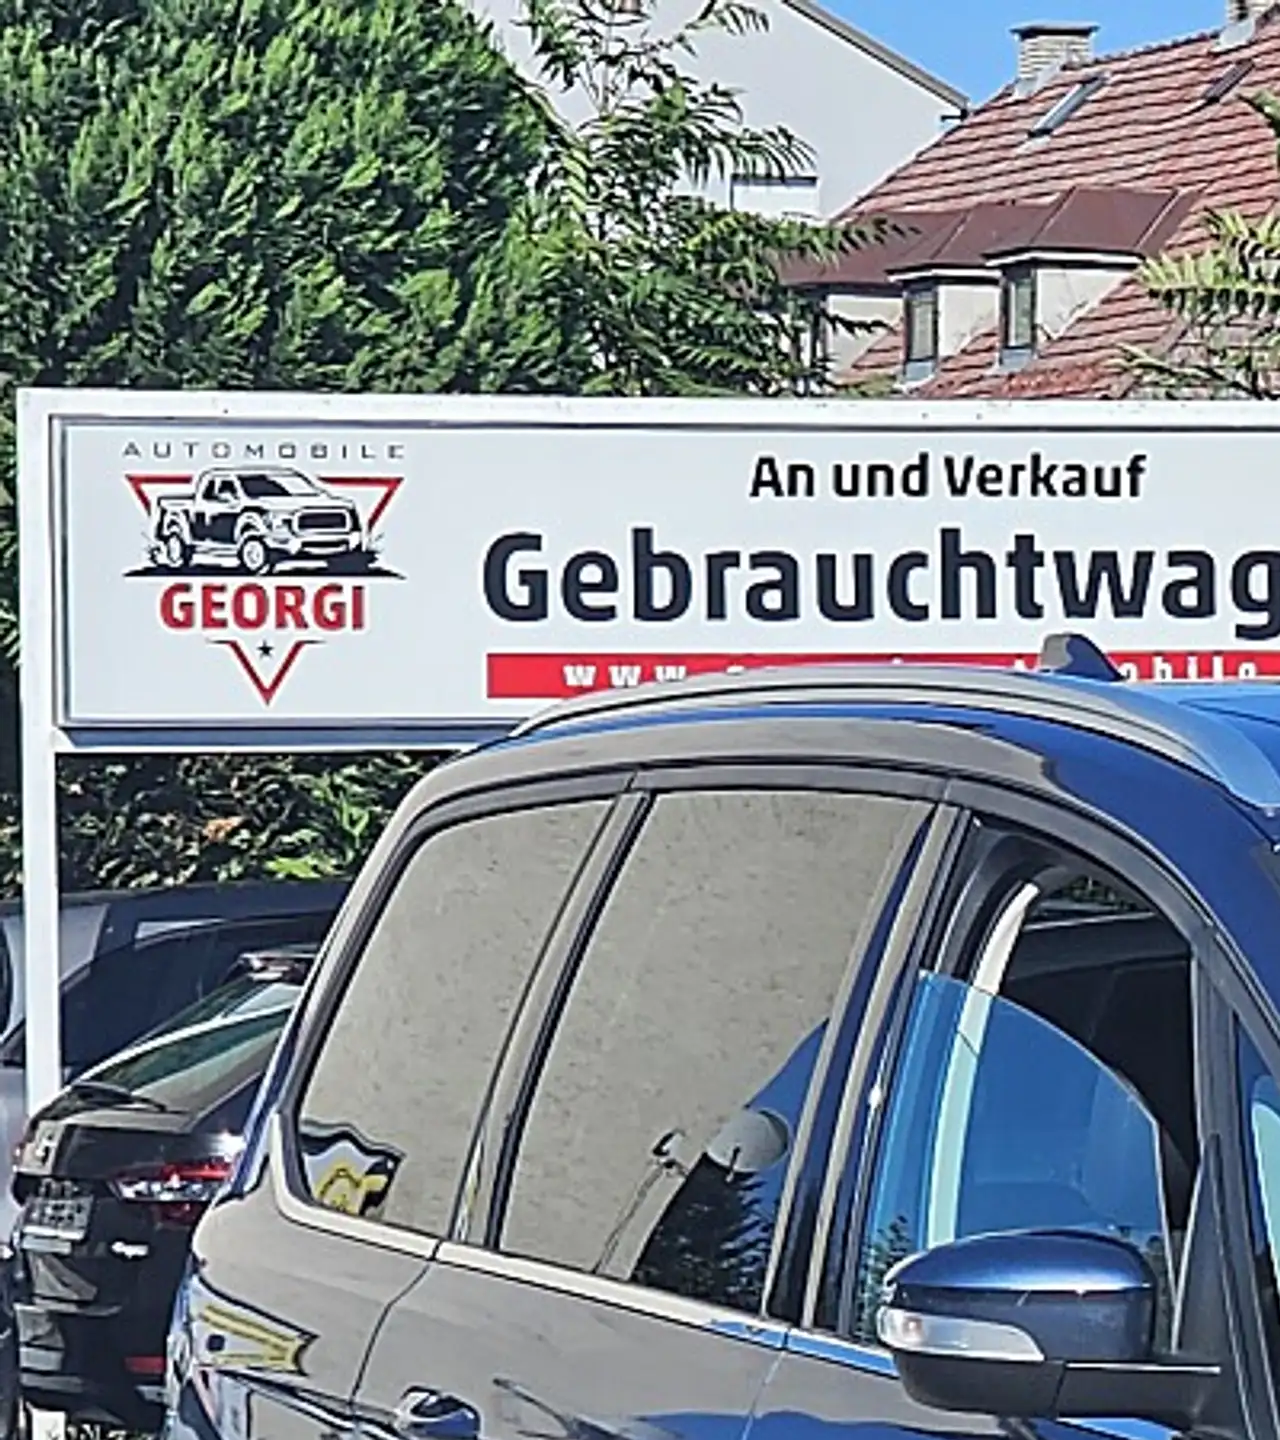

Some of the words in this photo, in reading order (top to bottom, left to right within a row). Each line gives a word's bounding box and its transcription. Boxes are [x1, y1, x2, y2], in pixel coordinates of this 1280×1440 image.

[122, 442, 405, 460] AUTOMOBILE
[749, 455, 815, 498] An
[833, 452, 930, 498] und
[943, 452, 1148, 498] Verkauf
[160, 582, 365, 631] GEORGI
